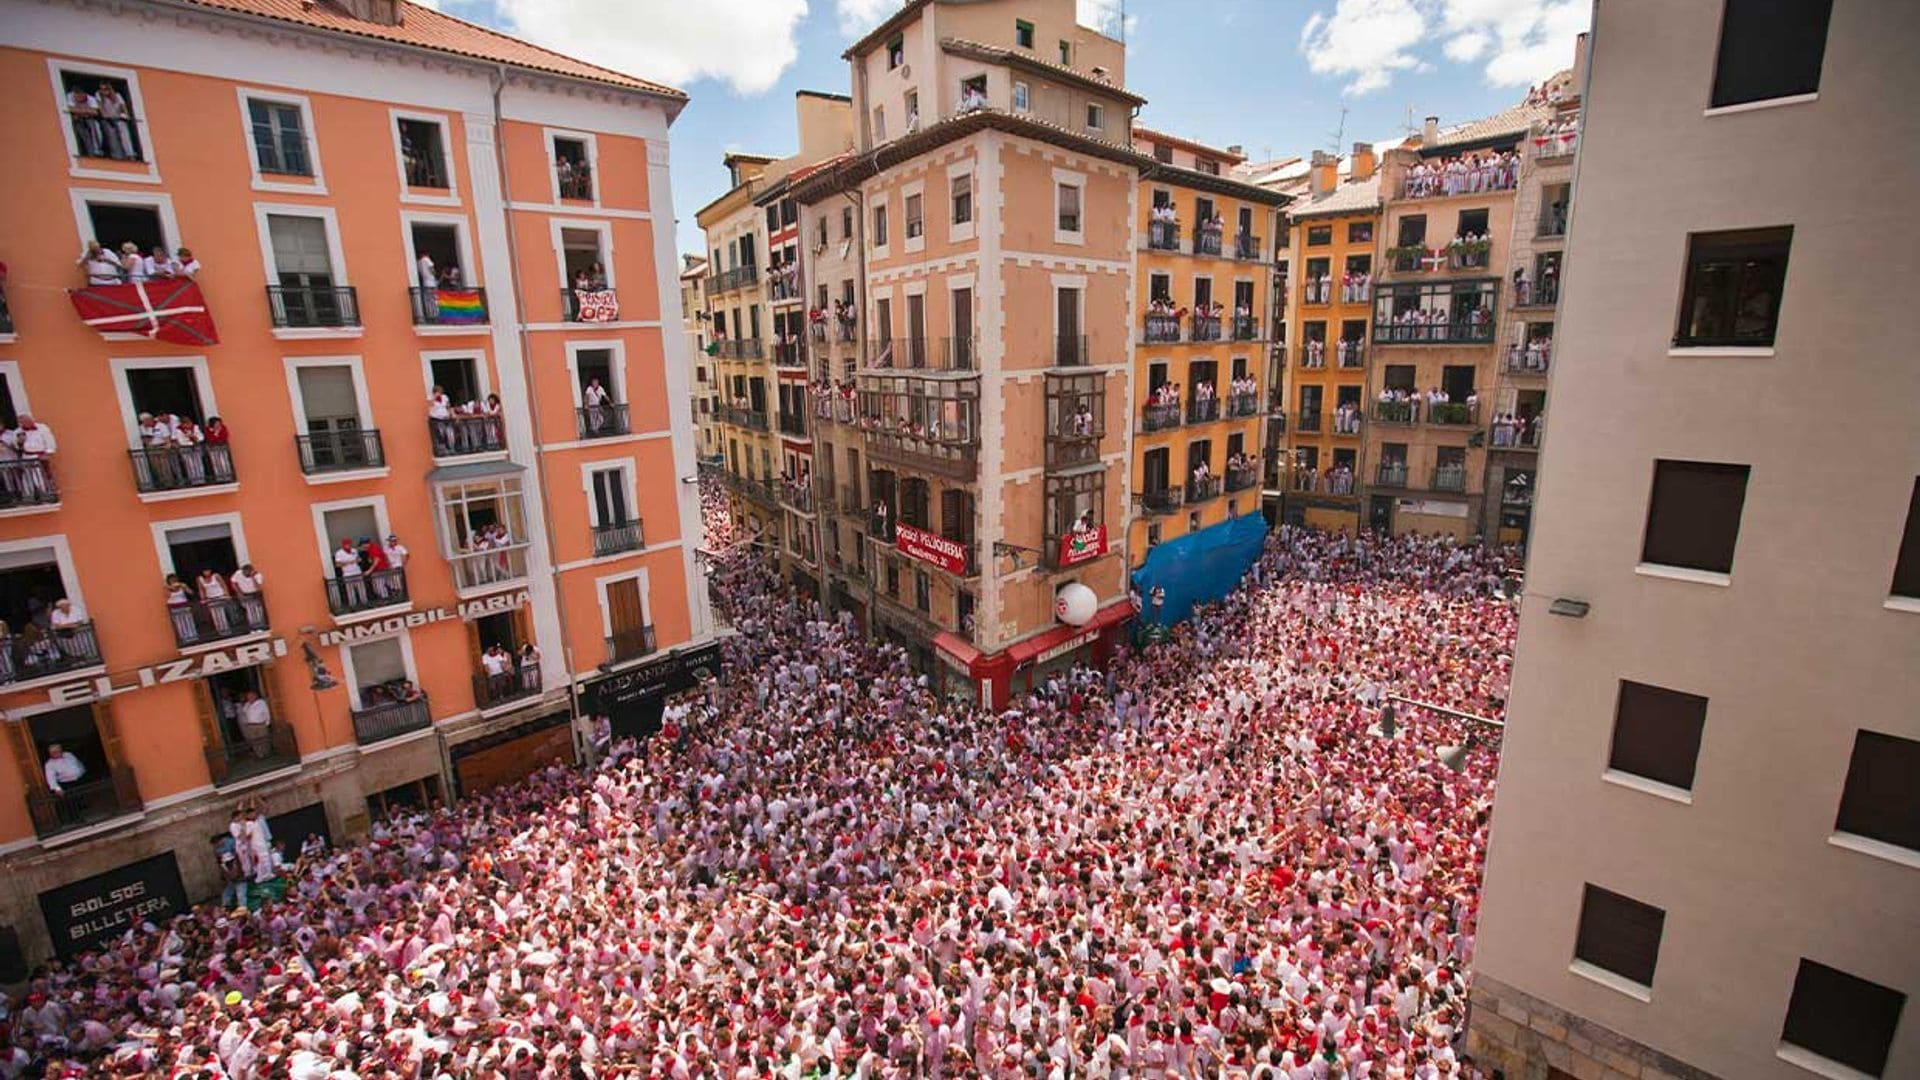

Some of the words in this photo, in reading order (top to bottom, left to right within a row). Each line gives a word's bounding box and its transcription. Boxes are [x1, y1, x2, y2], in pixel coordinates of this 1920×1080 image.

[319, 591, 533, 647] INMOBILIARIA
[69, 896, 171, 940] BILLETERA
[70, 880, 145, 918] BOLSOS
